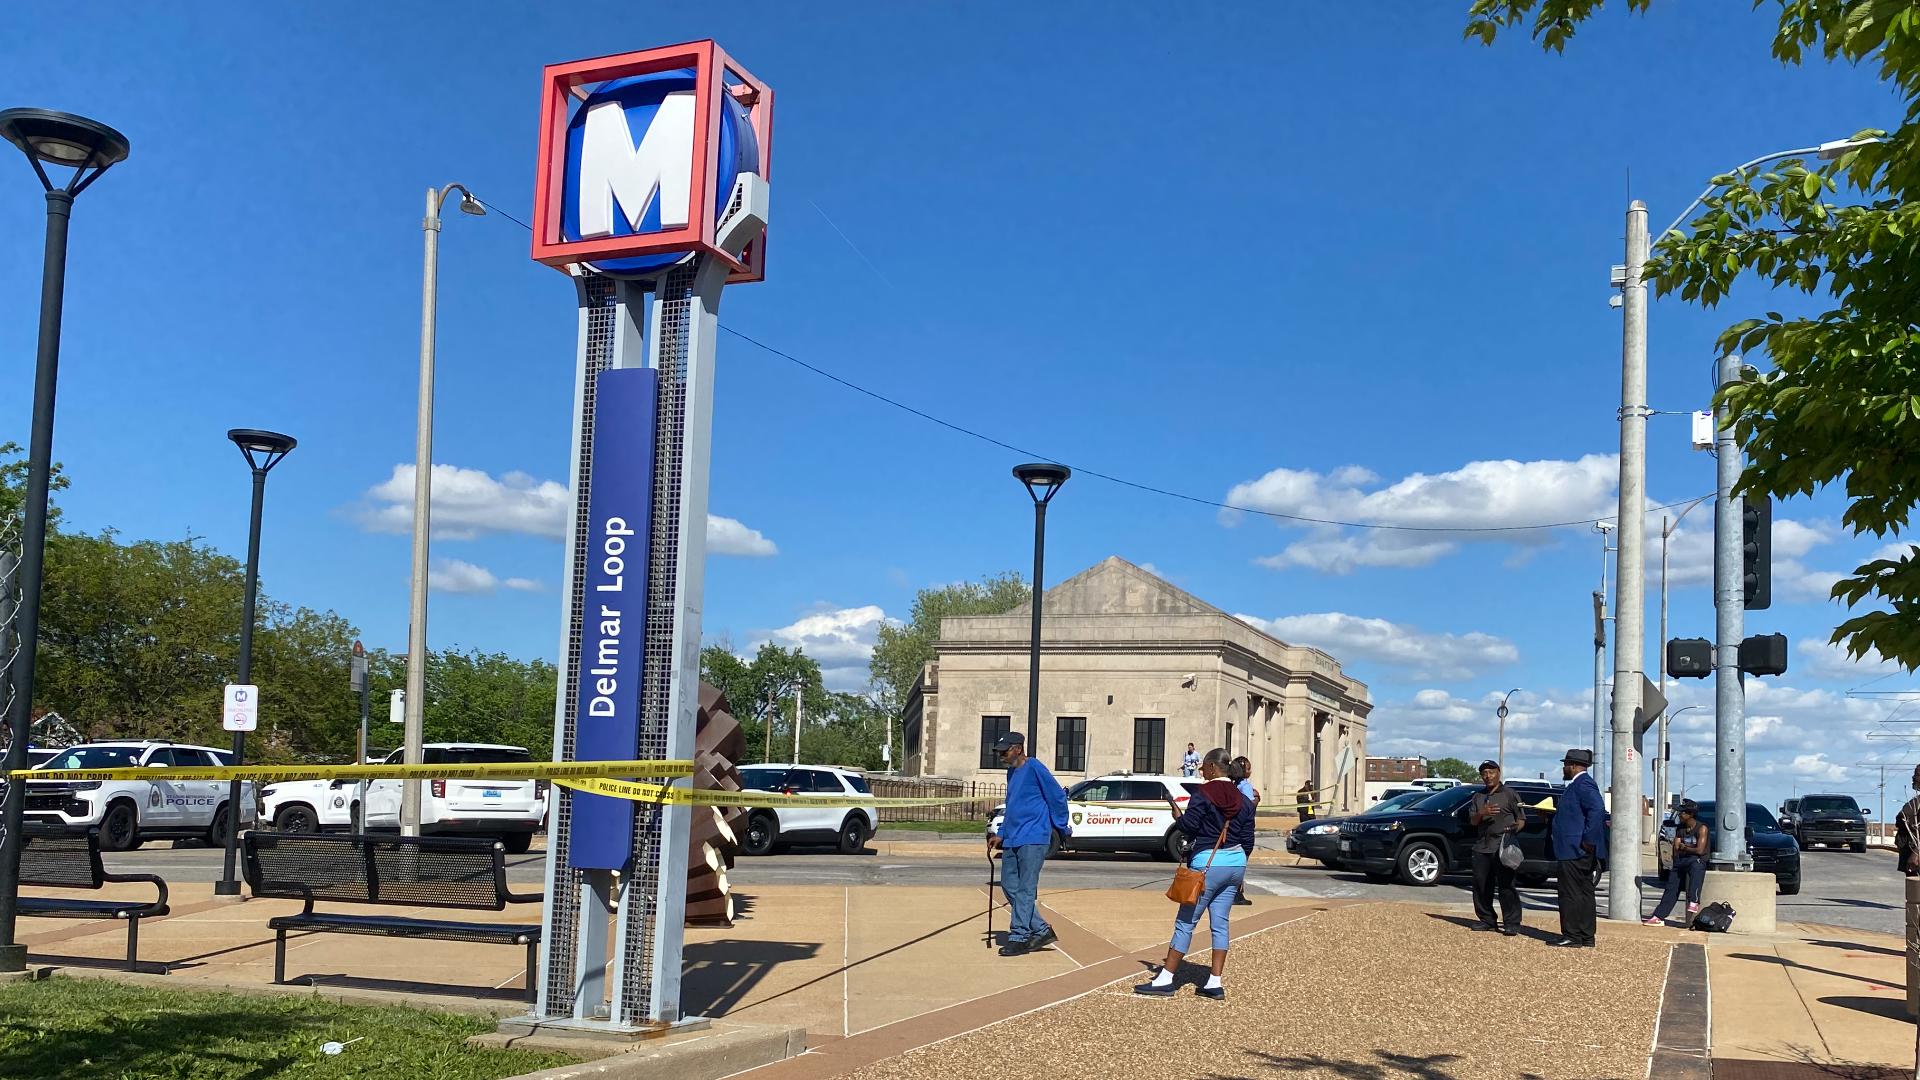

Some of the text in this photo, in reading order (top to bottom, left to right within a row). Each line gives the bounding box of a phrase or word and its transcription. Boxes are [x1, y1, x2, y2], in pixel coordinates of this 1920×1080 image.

[579, 90, 696, 239] M
[588, 517, 635, 718] Delmar Loop
[599, 782, 617, 793] POLICE
[618, 785, 631, 795] LINE
[632, 787, 641, 796] DO
[641, 788, 654, 797] NOT
[166, 798, 214, 806] POLICE
[1087, 816, 1154, 825] COUNTY POLICE
